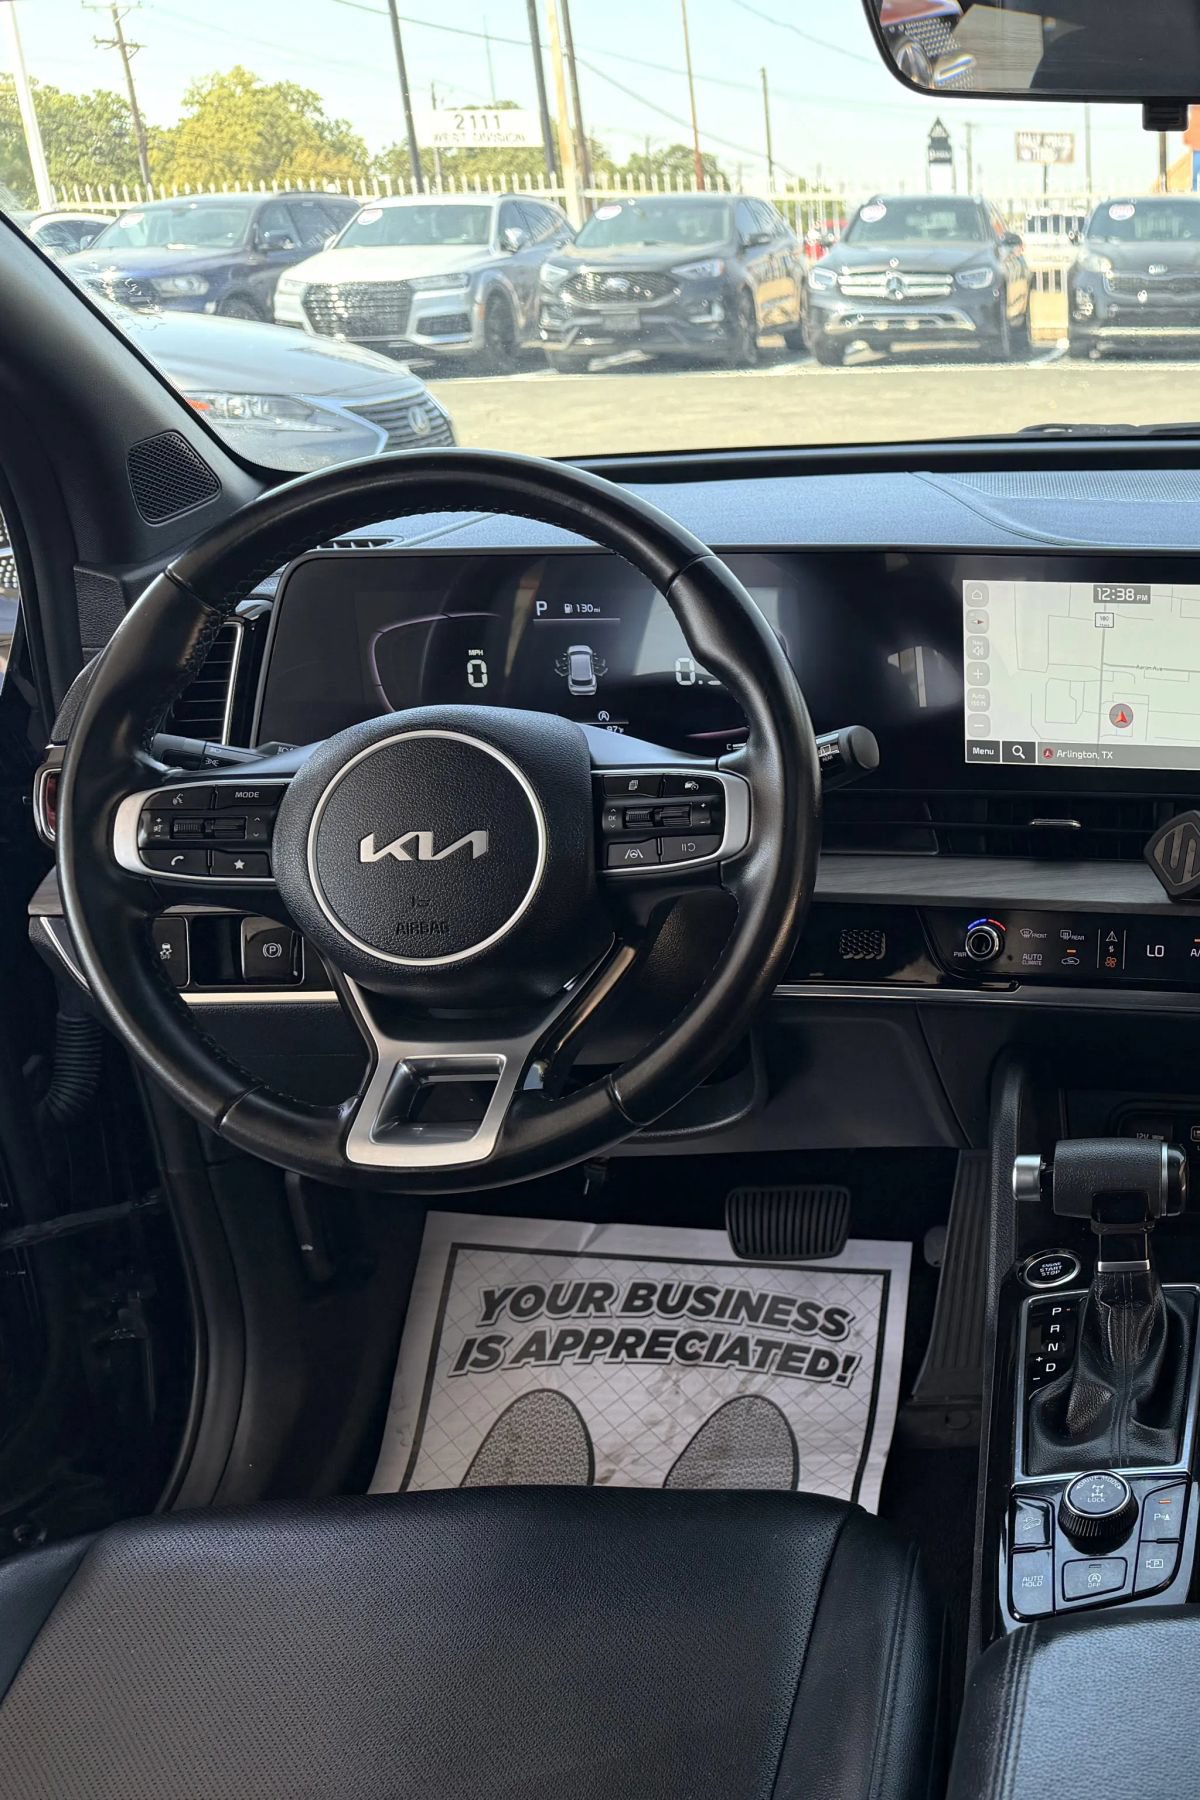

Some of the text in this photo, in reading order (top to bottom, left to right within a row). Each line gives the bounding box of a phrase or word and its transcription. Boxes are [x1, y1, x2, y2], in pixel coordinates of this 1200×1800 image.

[454, 114, 500, 129] 2111
[1096, 587, 1135, 600] 12:38
[536, 600, 548, 616] P
[466, 659, 488, 688] 0
[972, 747, 995, 756] Menu
[1056, 749, 1113, 760] Arlington, TX
[235, 790, 260, 799] MODE
[360, 830, 488, 862] KIA
[396, 919, 451, 935] AIRBAG
[1022, 953, 1043, 961] AUTO
[1146, 945, 1165, 957] LO
[1040, 1265, 1062, 1273] START
[479, 1280, 853, 1338] YOUR BUSINESS
[1051, 1307, 1062, 1316] P
[1050, 1324, 1060, 1334] R
[1047, 1342, 1058, 1352] N
[451, 1327, 859, 1384] IS APPRECIATED!
[1045, 1362, 1056, 1372] D
[1079, 1475, 1120, 1489] DRIVE MODE
